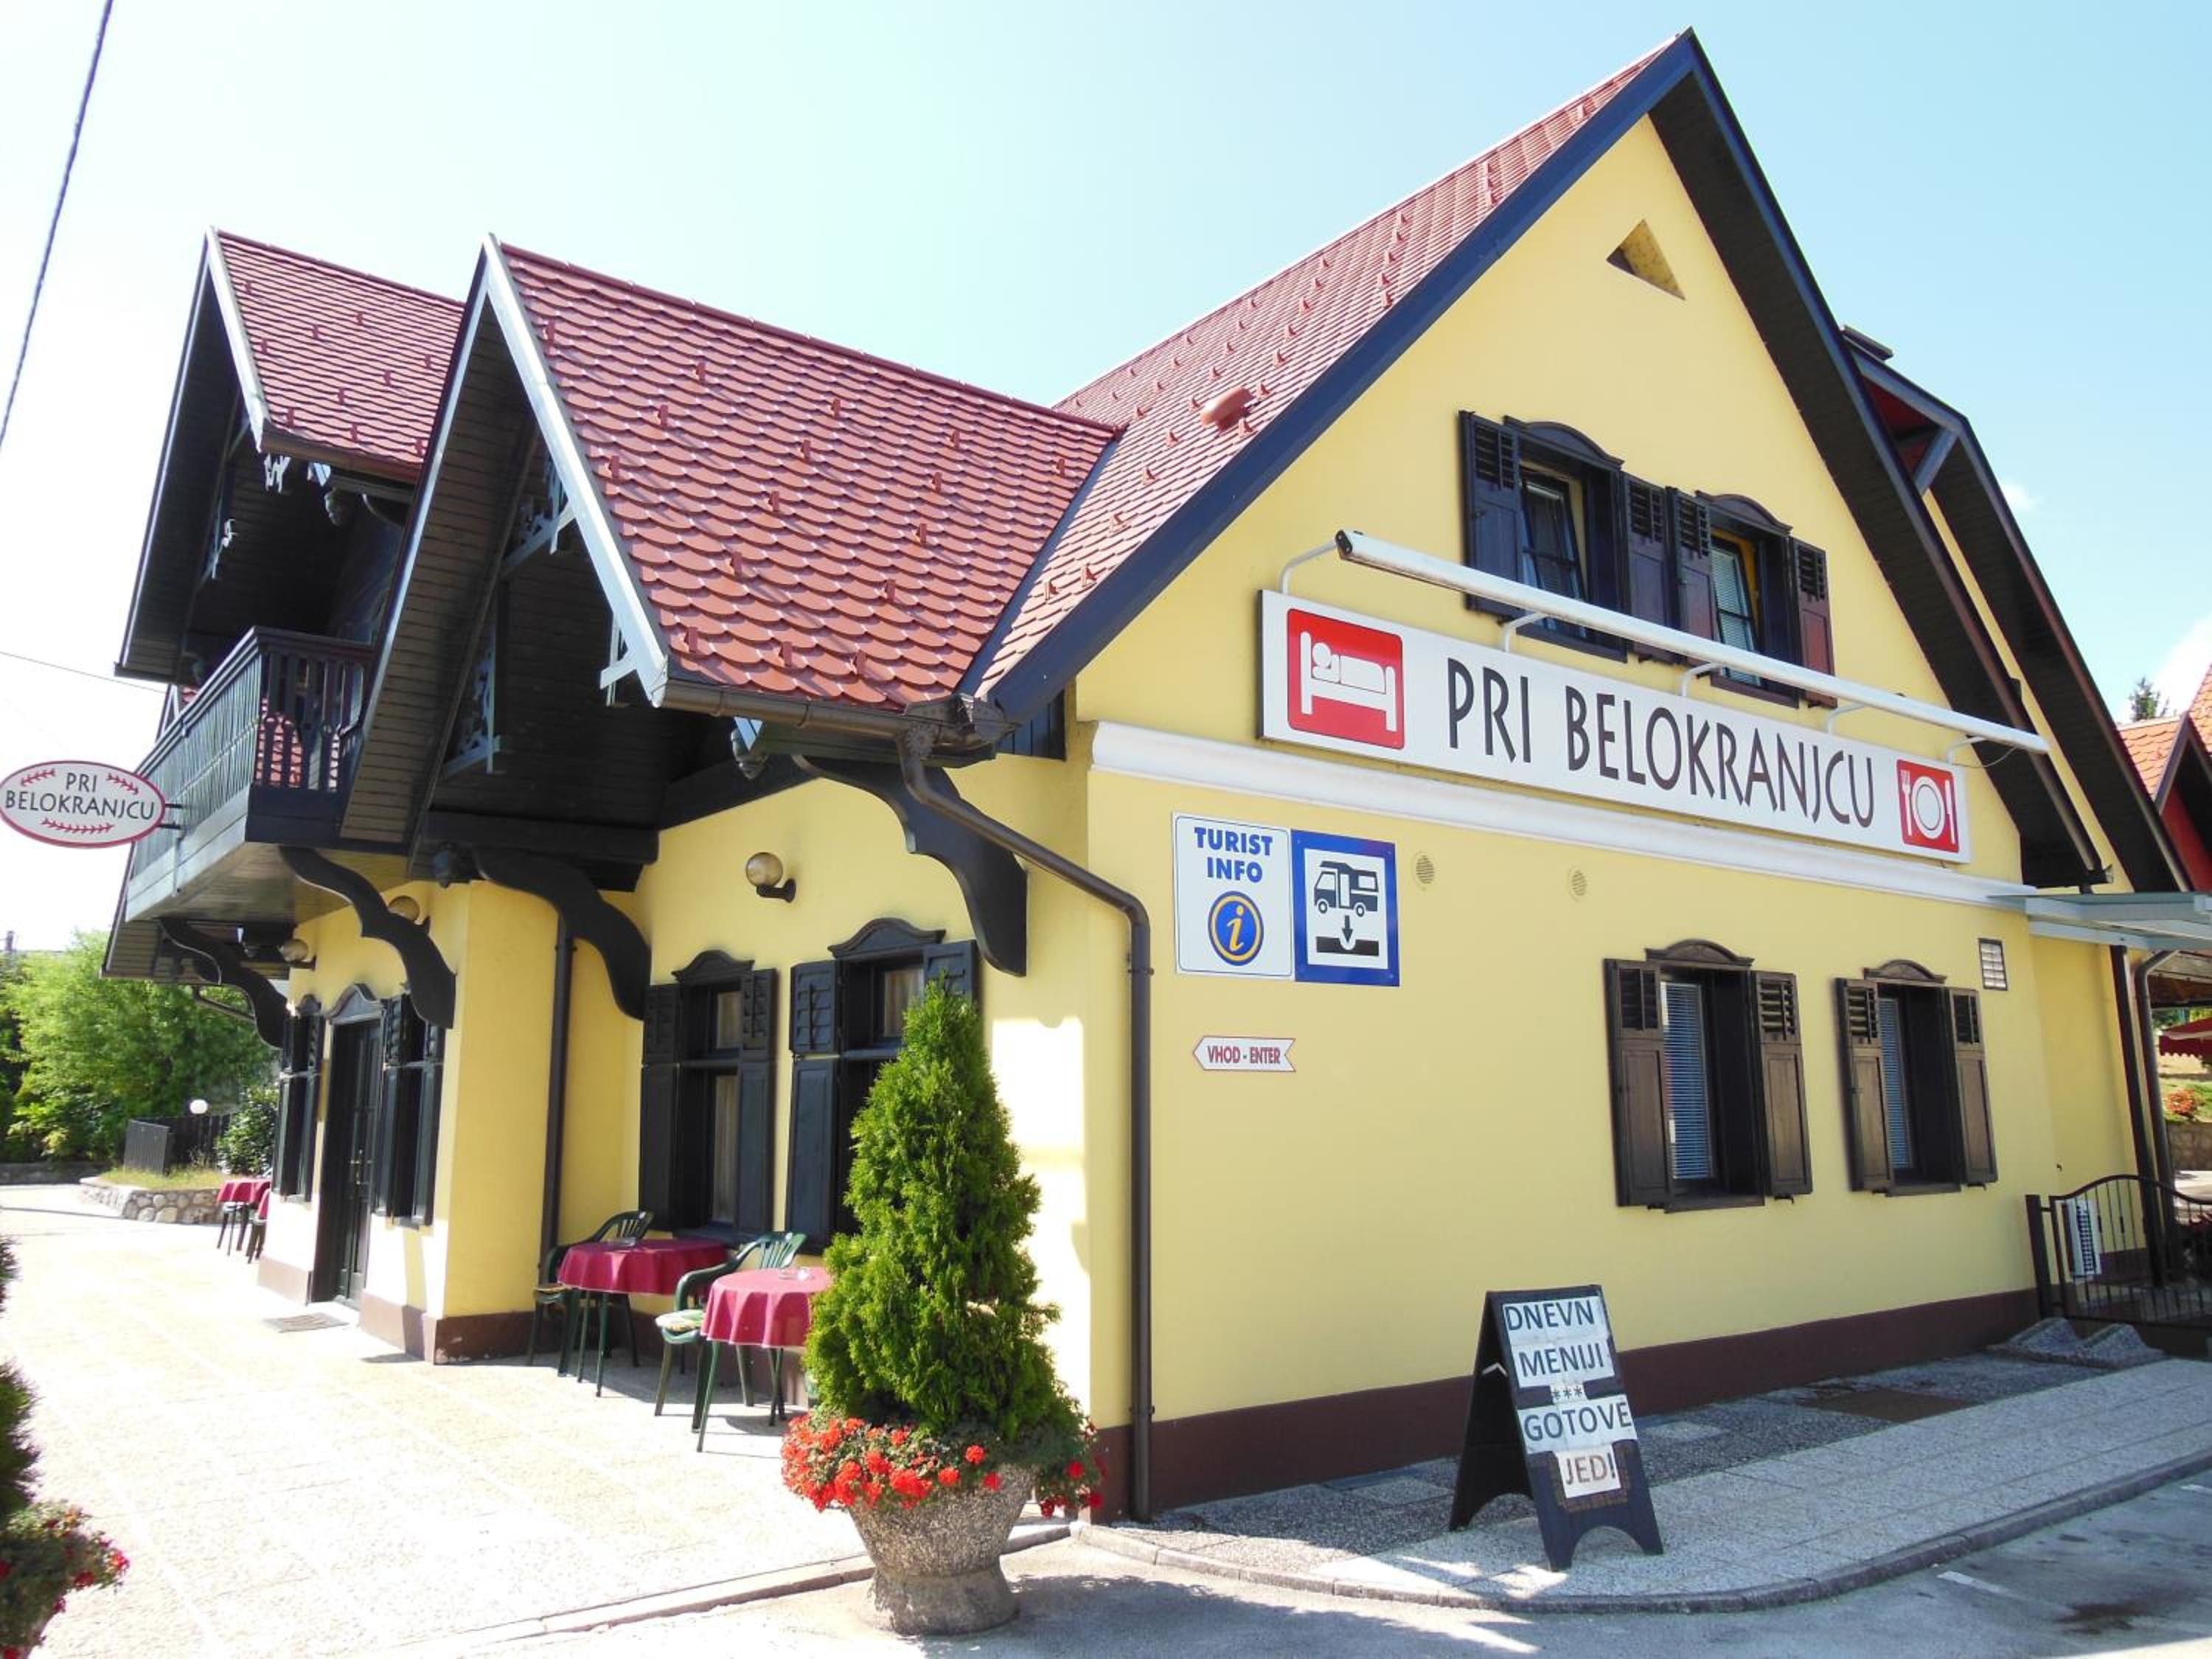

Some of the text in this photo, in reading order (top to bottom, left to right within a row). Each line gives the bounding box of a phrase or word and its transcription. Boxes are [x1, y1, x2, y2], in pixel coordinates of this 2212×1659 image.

[1448, 658, 1874, 828] PRI BELOKRANJCU
[66, 773, 97, 793] PRI
[5, 790, 155, 820] BELOKRANJCU
[1194, 827, 1273, 856] TURIST
[1207, 857, 1263, 883] INFO
[1207, 1046, 1281, 1064] VHOD ENTER
[1519, 1343, 1604, 1377] MENIJI
[1523, 1402, 1632, 1441] GOTOVE
